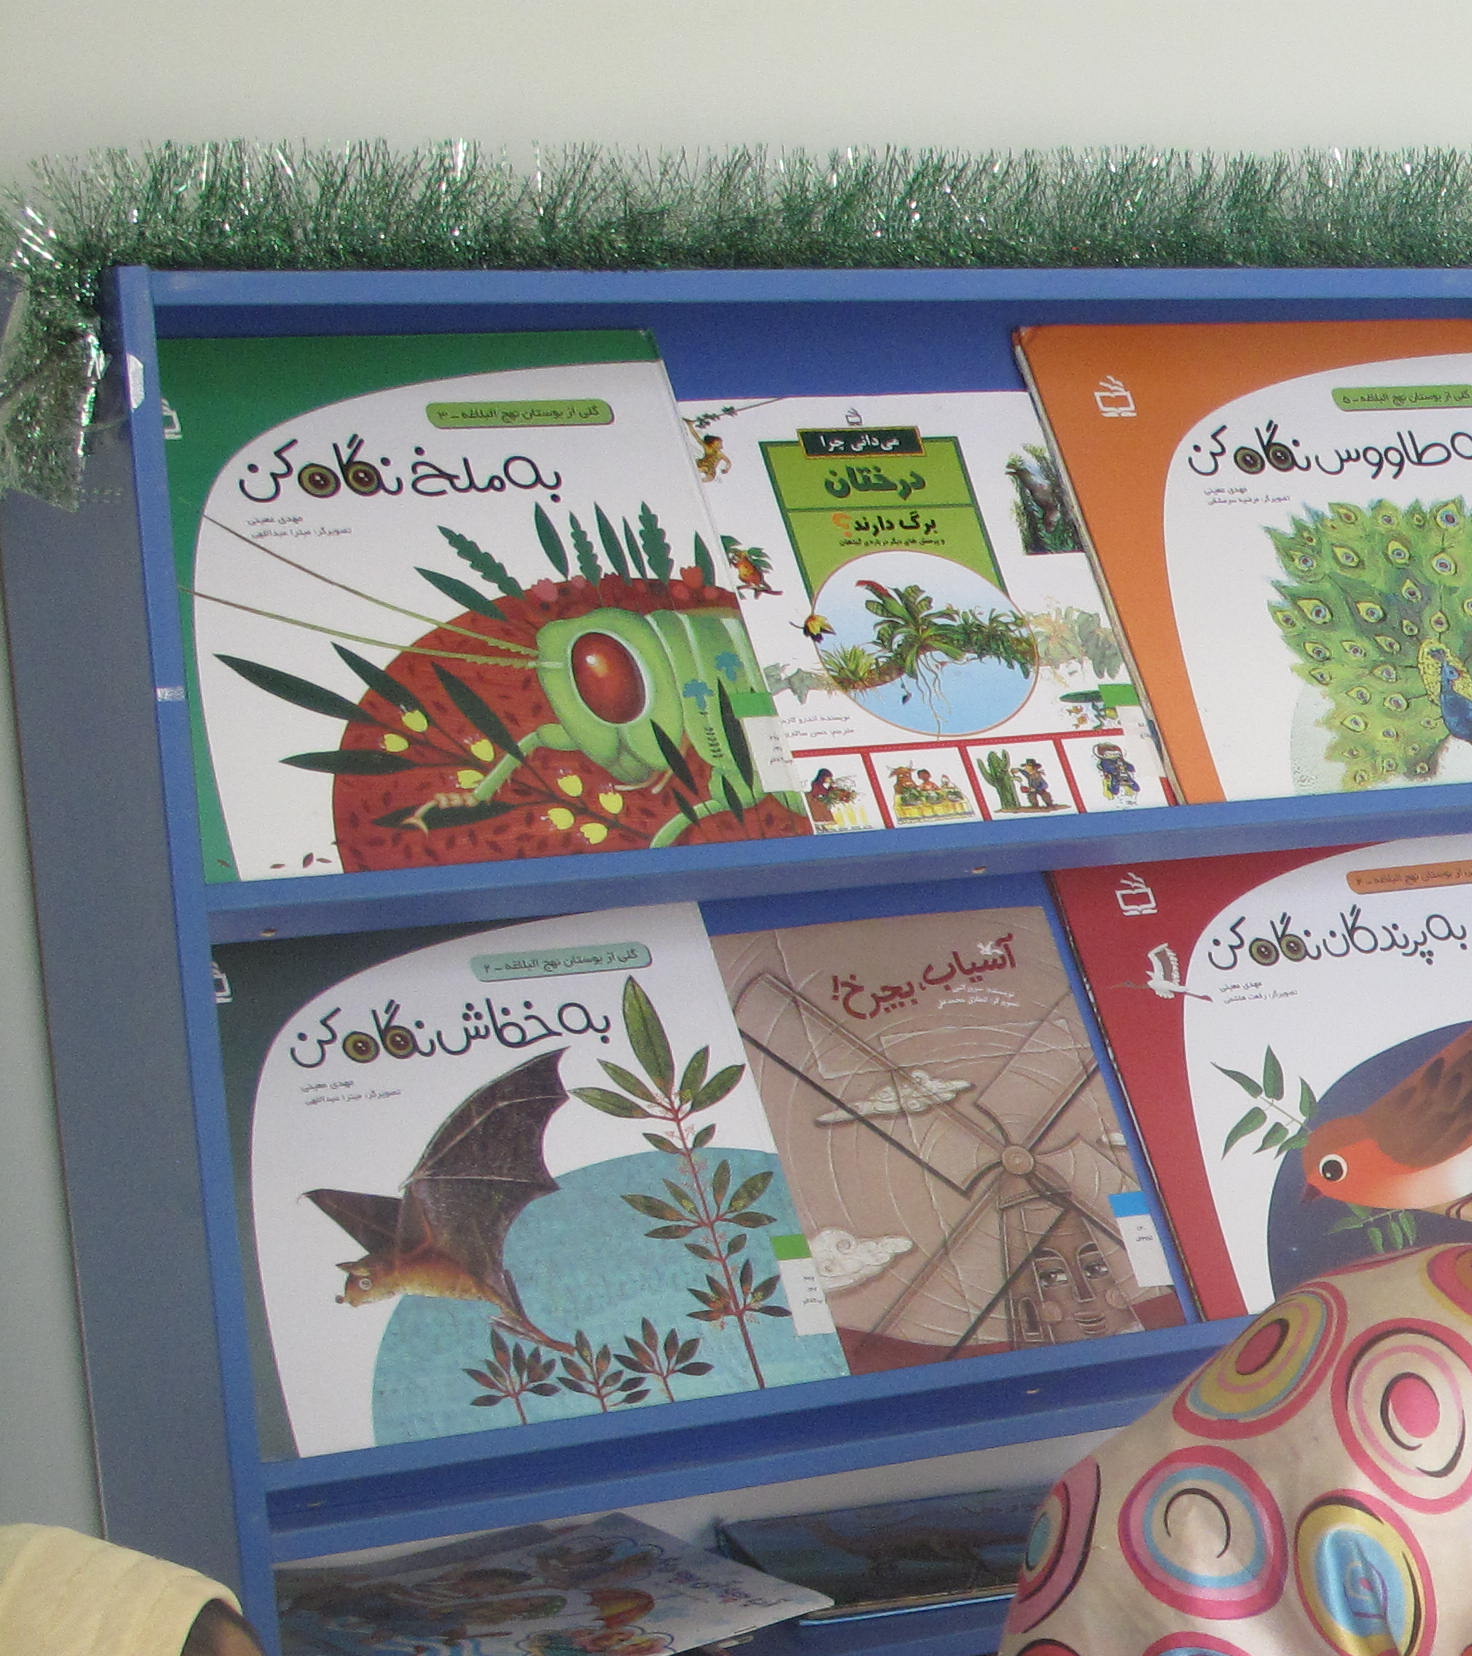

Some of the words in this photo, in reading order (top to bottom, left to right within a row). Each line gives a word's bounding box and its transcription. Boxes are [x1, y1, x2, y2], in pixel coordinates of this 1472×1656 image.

[522, 408, 563, 420] بوستان
[298, 433, 403, 498] نگاه
[820, 435, 846, 452] چرا
[1188, 423, 1229, 476] کن
[1232, 420, 1311, 475] نگاه
[1316, 429, 1451, 480] طاووس
[239, 438, 299, 504] کن
[411, 445, 507, 497] ملخ
[504, 455, 562, 503] به
[823, 464, 927, 500] درختان
[899, 510, 938, 535] برگ
[1208, 916, 1246, 970] کن
[1248, 911, 1322, 967] نگاه
[1323, 904, 1433, 965] پرندگان
[1426, 914, 1468, 950] به
[563, 955, 603, 968] بوستان
[290, 1007, 342, 1068] کن
[341, 999, 437, 1064] نگاه
[436, 997, 562, 1056] خفاش
[558, 1001, 612, 1044] به
